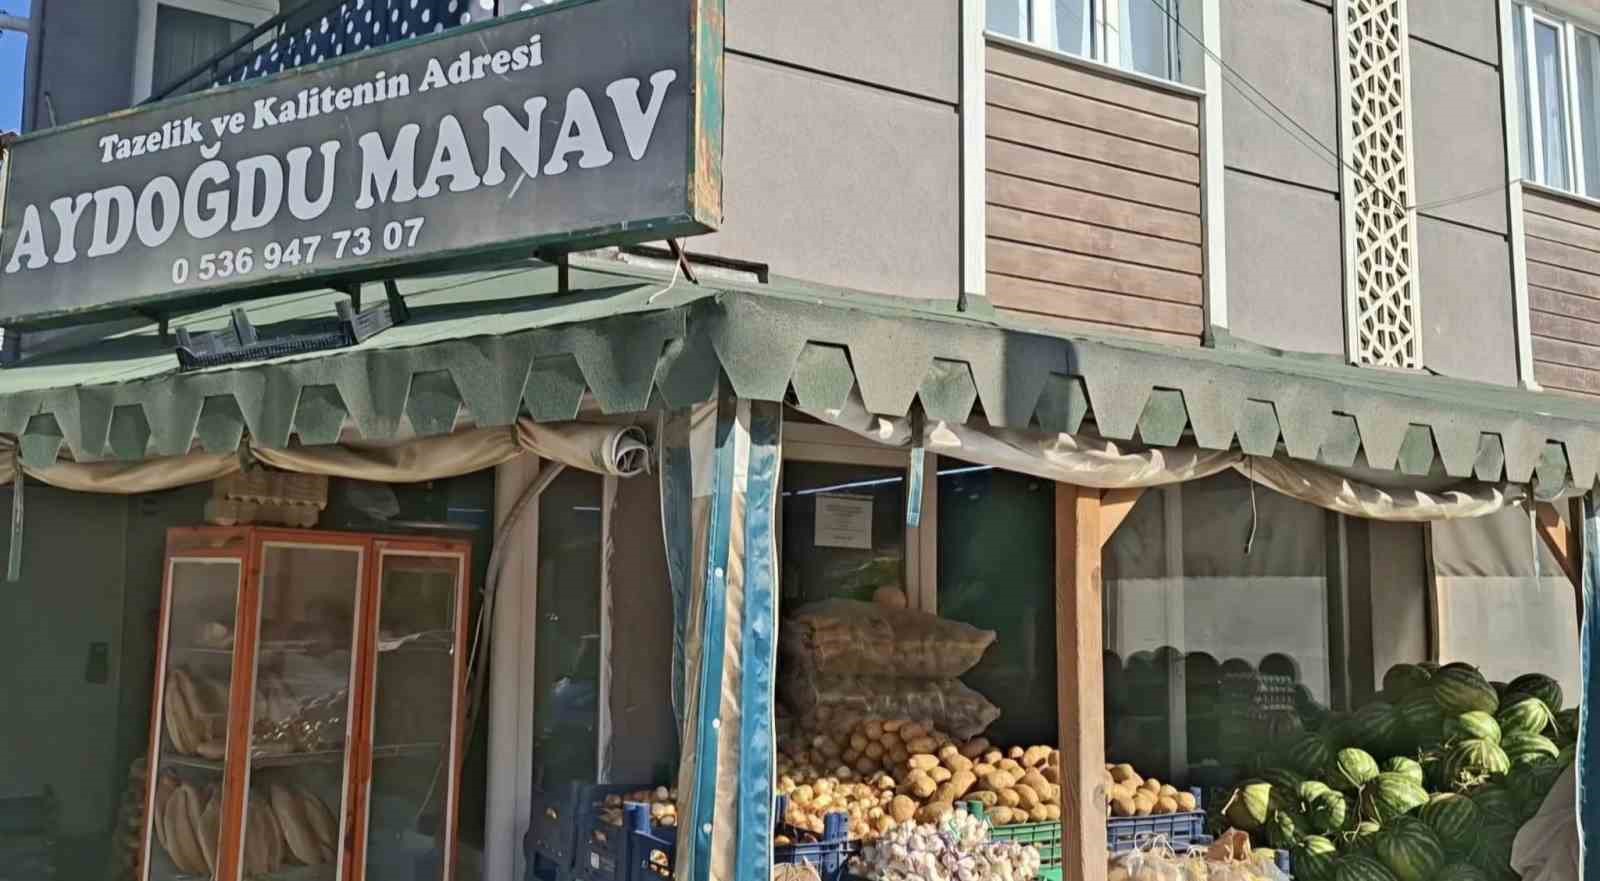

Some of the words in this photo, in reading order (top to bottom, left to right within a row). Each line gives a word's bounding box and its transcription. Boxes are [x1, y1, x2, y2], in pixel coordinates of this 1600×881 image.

[100, 116, 203, 163] Tazelik
[210, 112, 246, 137] ve
[253, 71, 410, 130] Kalitenin
[418, 35, 543, 92] Adresi
[5, 141, 341, 274] AYDOĞDU
[354, 69, 677, 210] MANAV
[172, 259, 189, 284] 0
[199, 247, 253, 280] 536
[263, 237, 321, 271] 947
[332, 228, 372, 258] 73
[384, 217, 425, 250] 07
